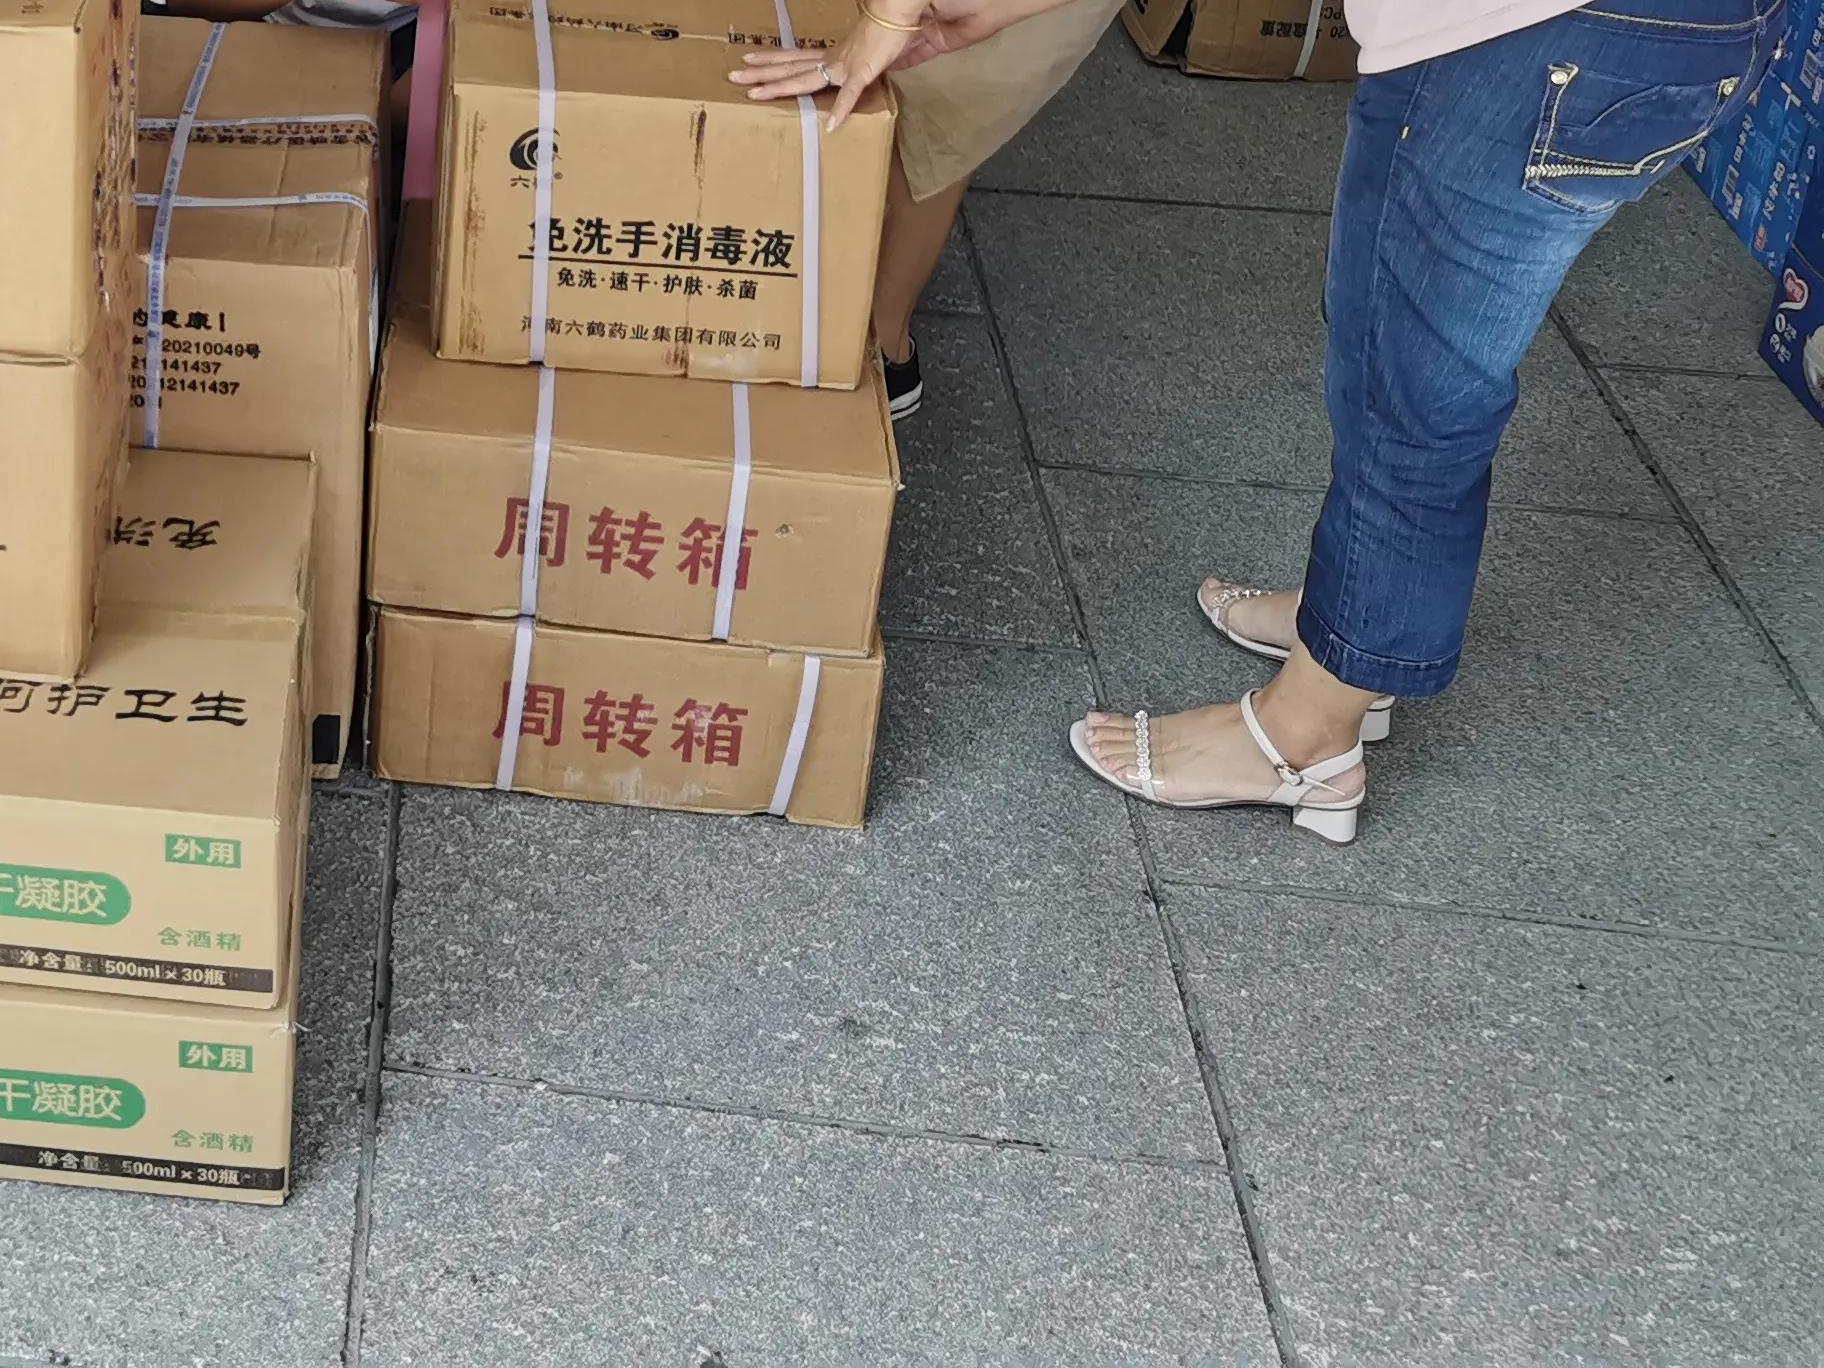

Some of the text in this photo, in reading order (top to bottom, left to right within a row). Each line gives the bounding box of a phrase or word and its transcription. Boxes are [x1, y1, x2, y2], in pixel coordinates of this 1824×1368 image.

[527, 217, 796, 269] 免洗手消毒液
[494, 495, 759, 591] 周转箱
[491, 680, 749, 767] 周转箱
[172, 838, 235, 866] 外用
[157, 927, 242, 952] 含酒精
[185, 1043, 249, 1070] 外用
[170, 1129, 254, 1154] 含酒精
